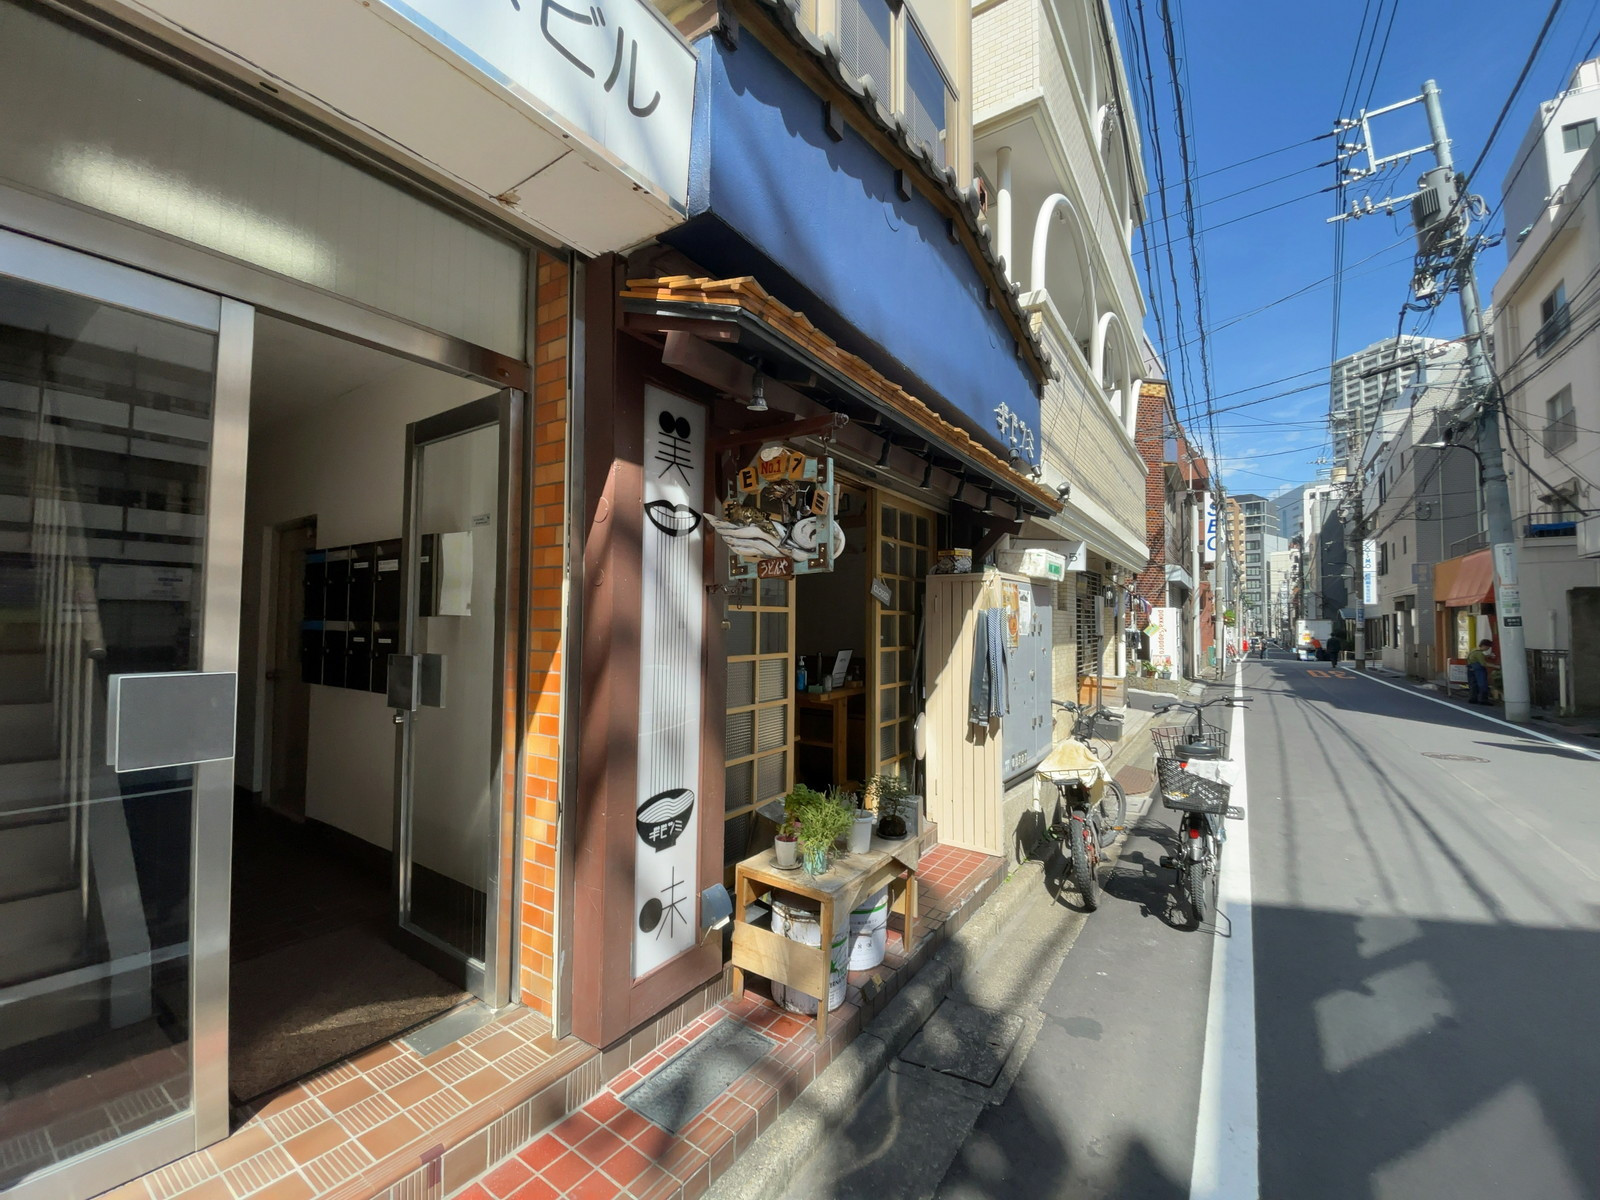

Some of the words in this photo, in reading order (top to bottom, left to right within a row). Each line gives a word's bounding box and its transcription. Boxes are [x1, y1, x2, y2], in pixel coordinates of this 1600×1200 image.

[511, 0, 661, 117] ビル
[761, 460, 781, 475] No.1
[761, 559, 788, 577] うどんや
